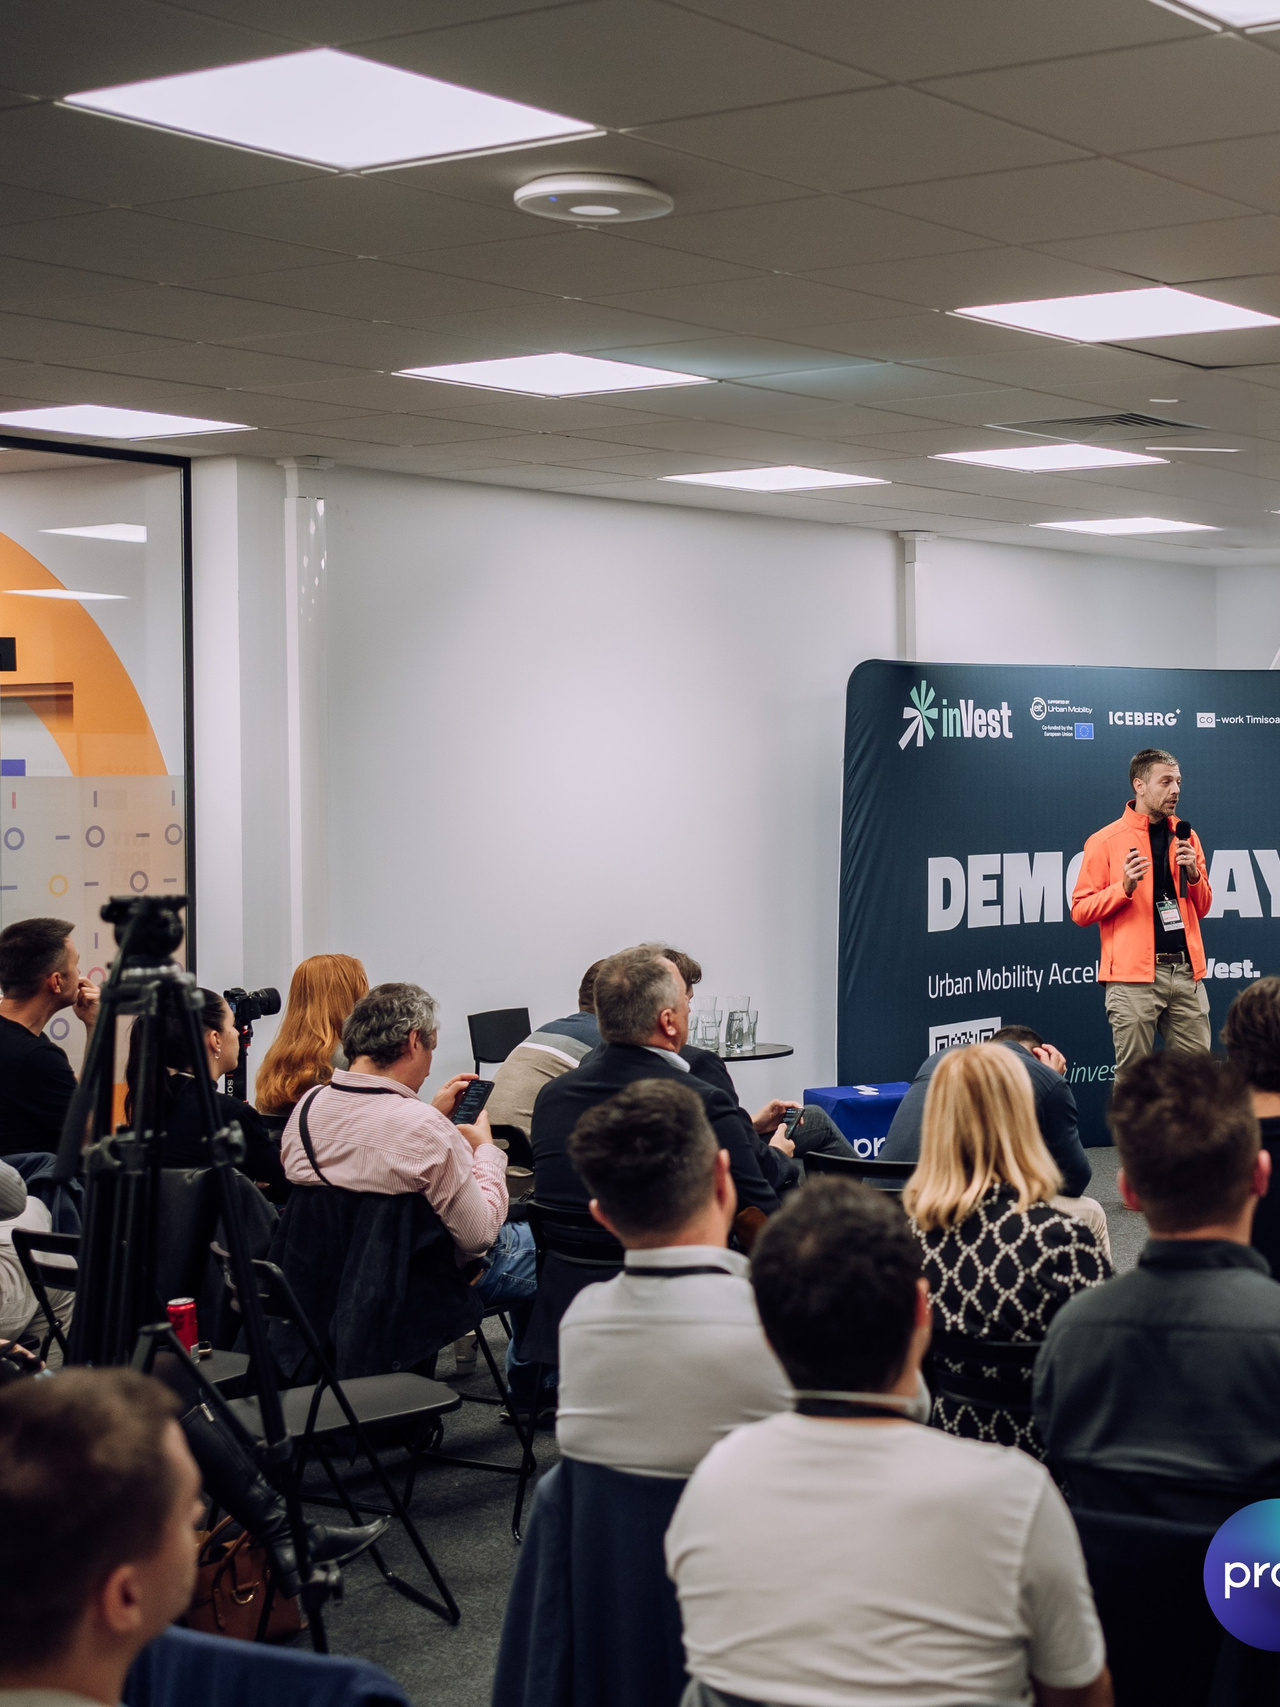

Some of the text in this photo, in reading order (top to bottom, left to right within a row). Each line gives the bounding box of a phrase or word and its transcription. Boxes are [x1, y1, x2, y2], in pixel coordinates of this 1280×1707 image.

[942, 699, 1013, 738] inVest
[1047, 705, 1068, 713] Urban
[1068, 705, 1093, 715] Mobility
[1061, 724, 1067, 732] by
[928, 973, 972, 999] Urban
[977, 965, 1044, 993] Mobility
[1048, 960, 1100, 985] Accel
[853, 1136, 886, 1158] pr
